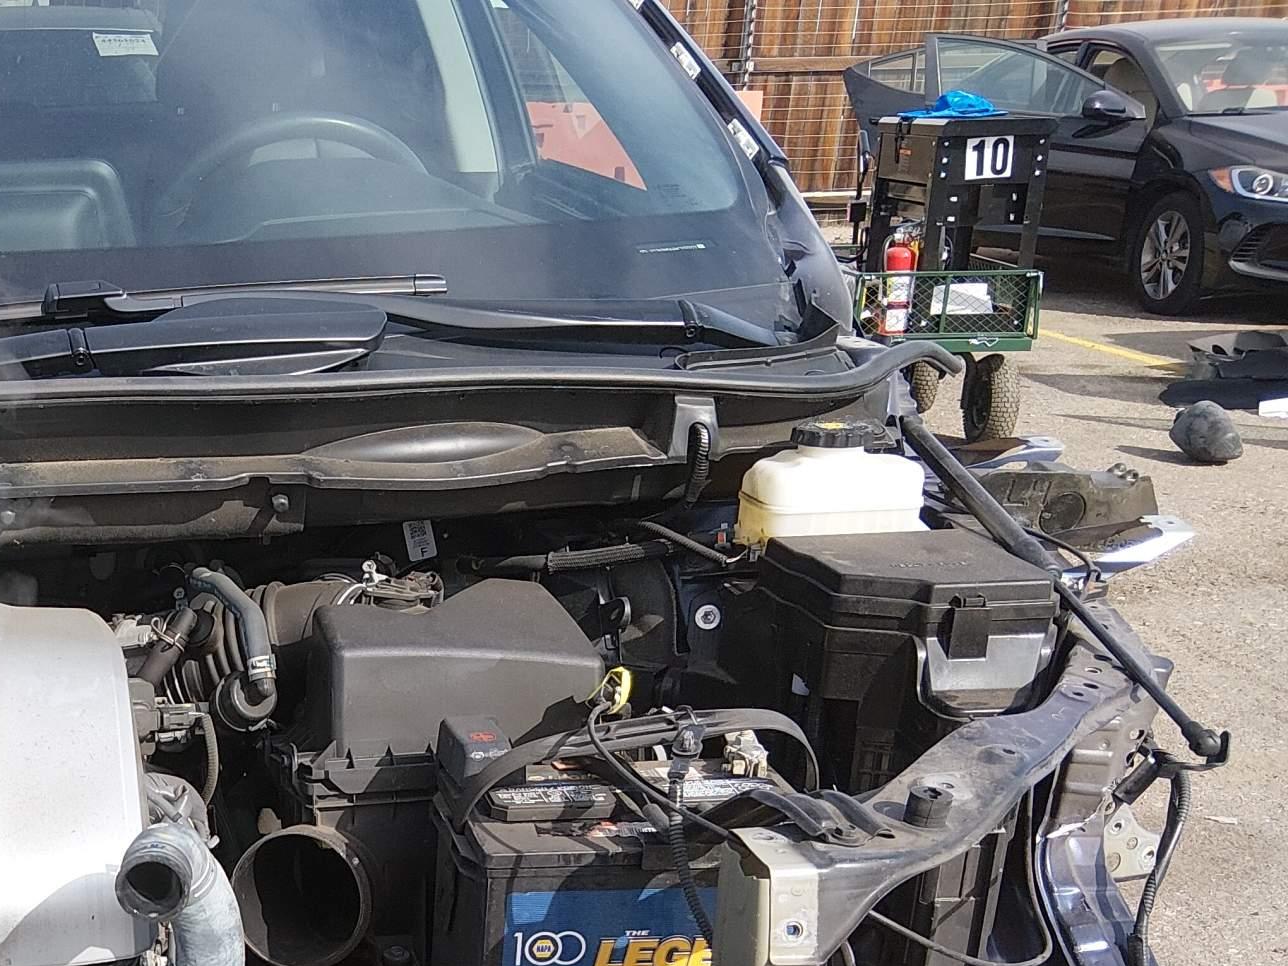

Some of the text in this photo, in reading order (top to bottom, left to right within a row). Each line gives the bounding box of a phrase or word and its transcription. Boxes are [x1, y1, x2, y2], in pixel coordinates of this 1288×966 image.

[971, 137, 1011, 177] 10
[624, 929, 650, 937] THE
[513, 930, 587, 966] 100
[535, 944, 553, 953] NAPA
